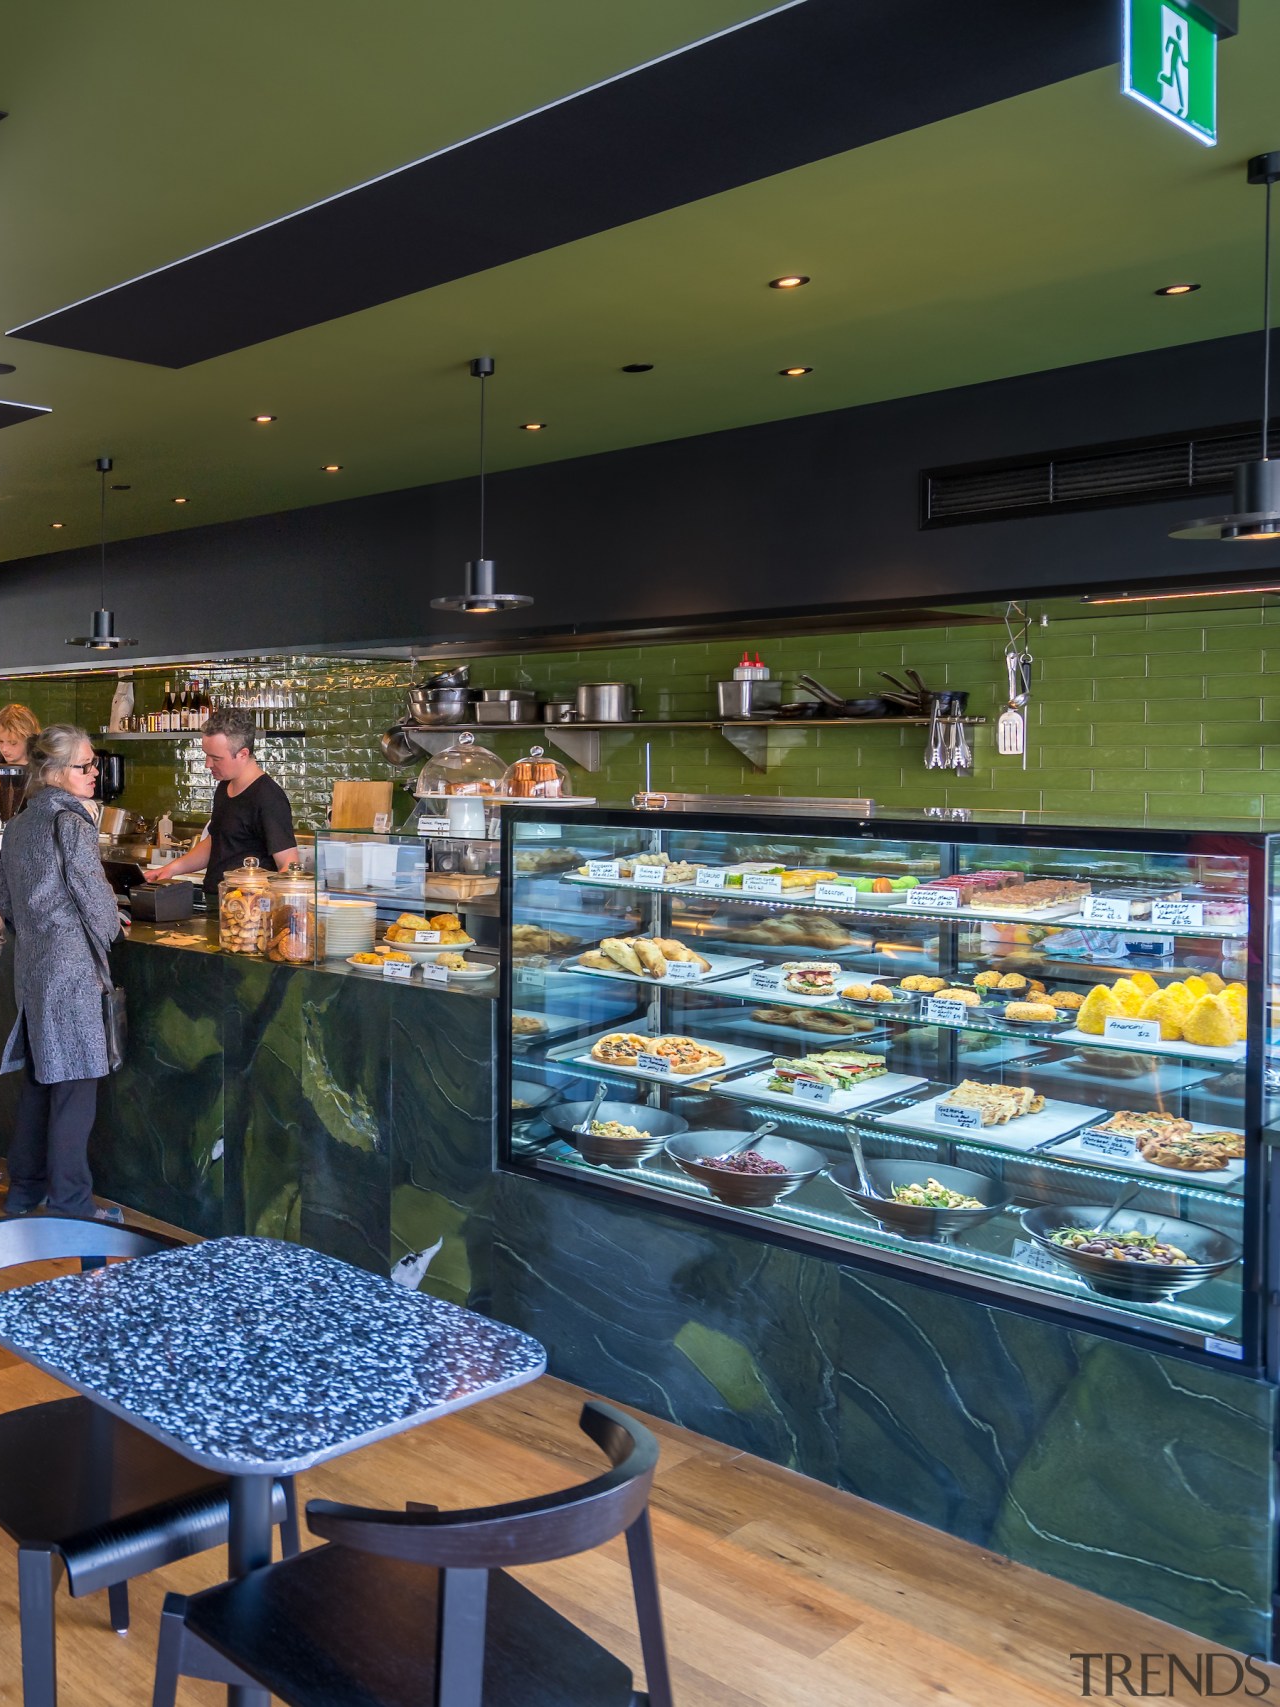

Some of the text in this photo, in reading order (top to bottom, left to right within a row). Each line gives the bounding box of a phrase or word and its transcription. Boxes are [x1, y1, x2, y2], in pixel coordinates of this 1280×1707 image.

[818, 886, 845, 896] Macaron
[1154, 902, 1189, 912] Raspberry
[1110, 1021, 1144, 1030] Arancini
